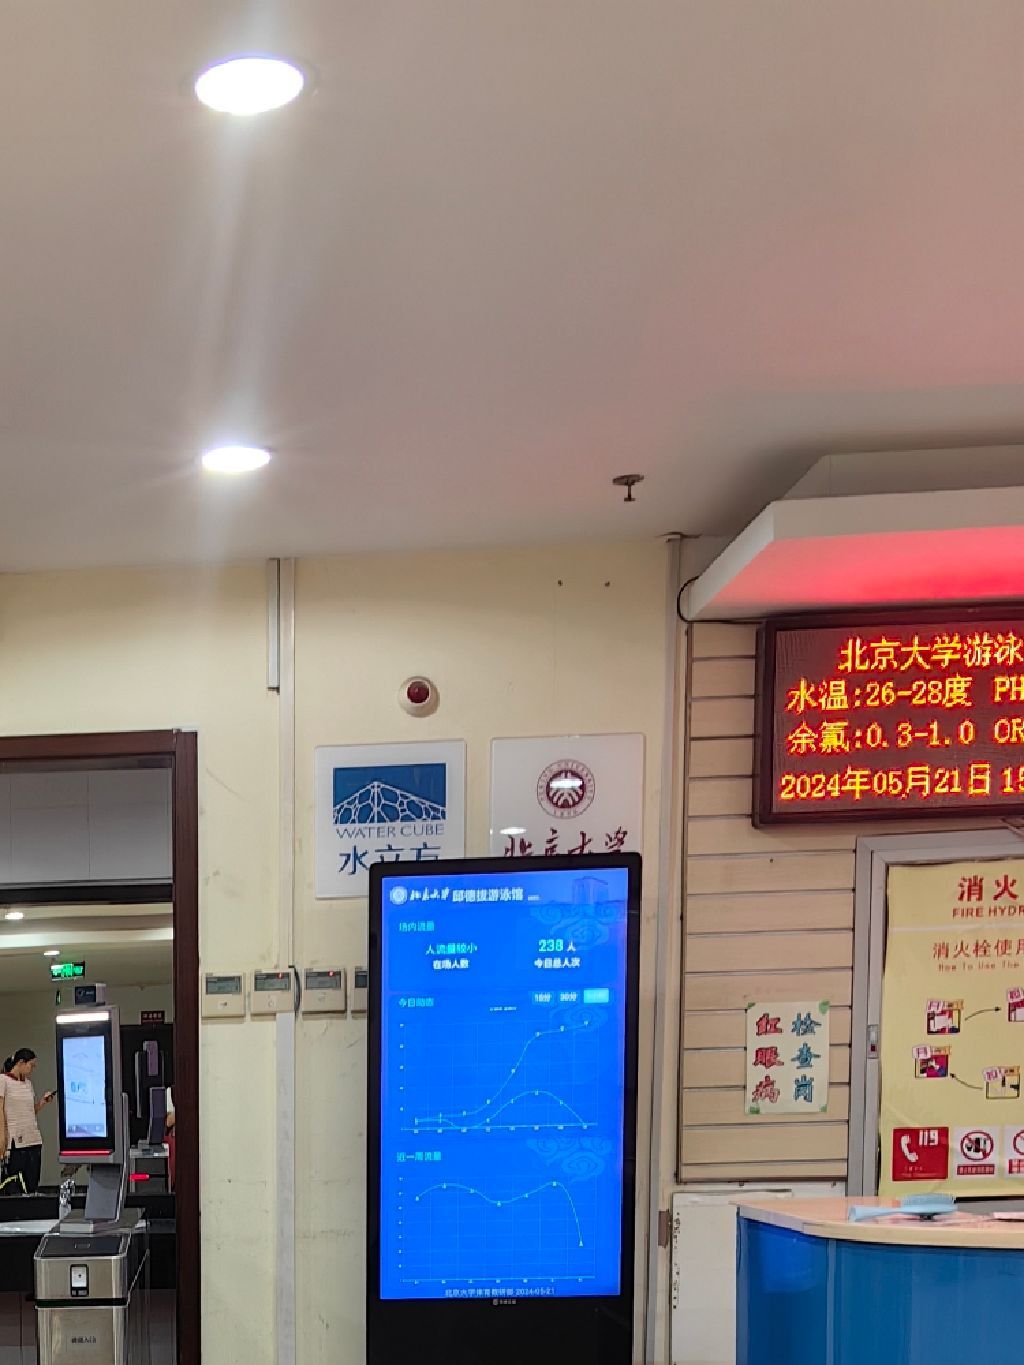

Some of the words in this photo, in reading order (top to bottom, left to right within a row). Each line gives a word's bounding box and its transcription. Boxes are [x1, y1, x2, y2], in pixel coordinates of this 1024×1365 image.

[838, 632, 1024, 673] 北京大学游泳
[780, 763, 991, 801] 2024年05月21日
[336, 825, 396, 839] WATER
[400, 823, 445, 837] CUBE
[958, 874, 1019, 902] 消火
[953, 907, 984, 919] FIRE
